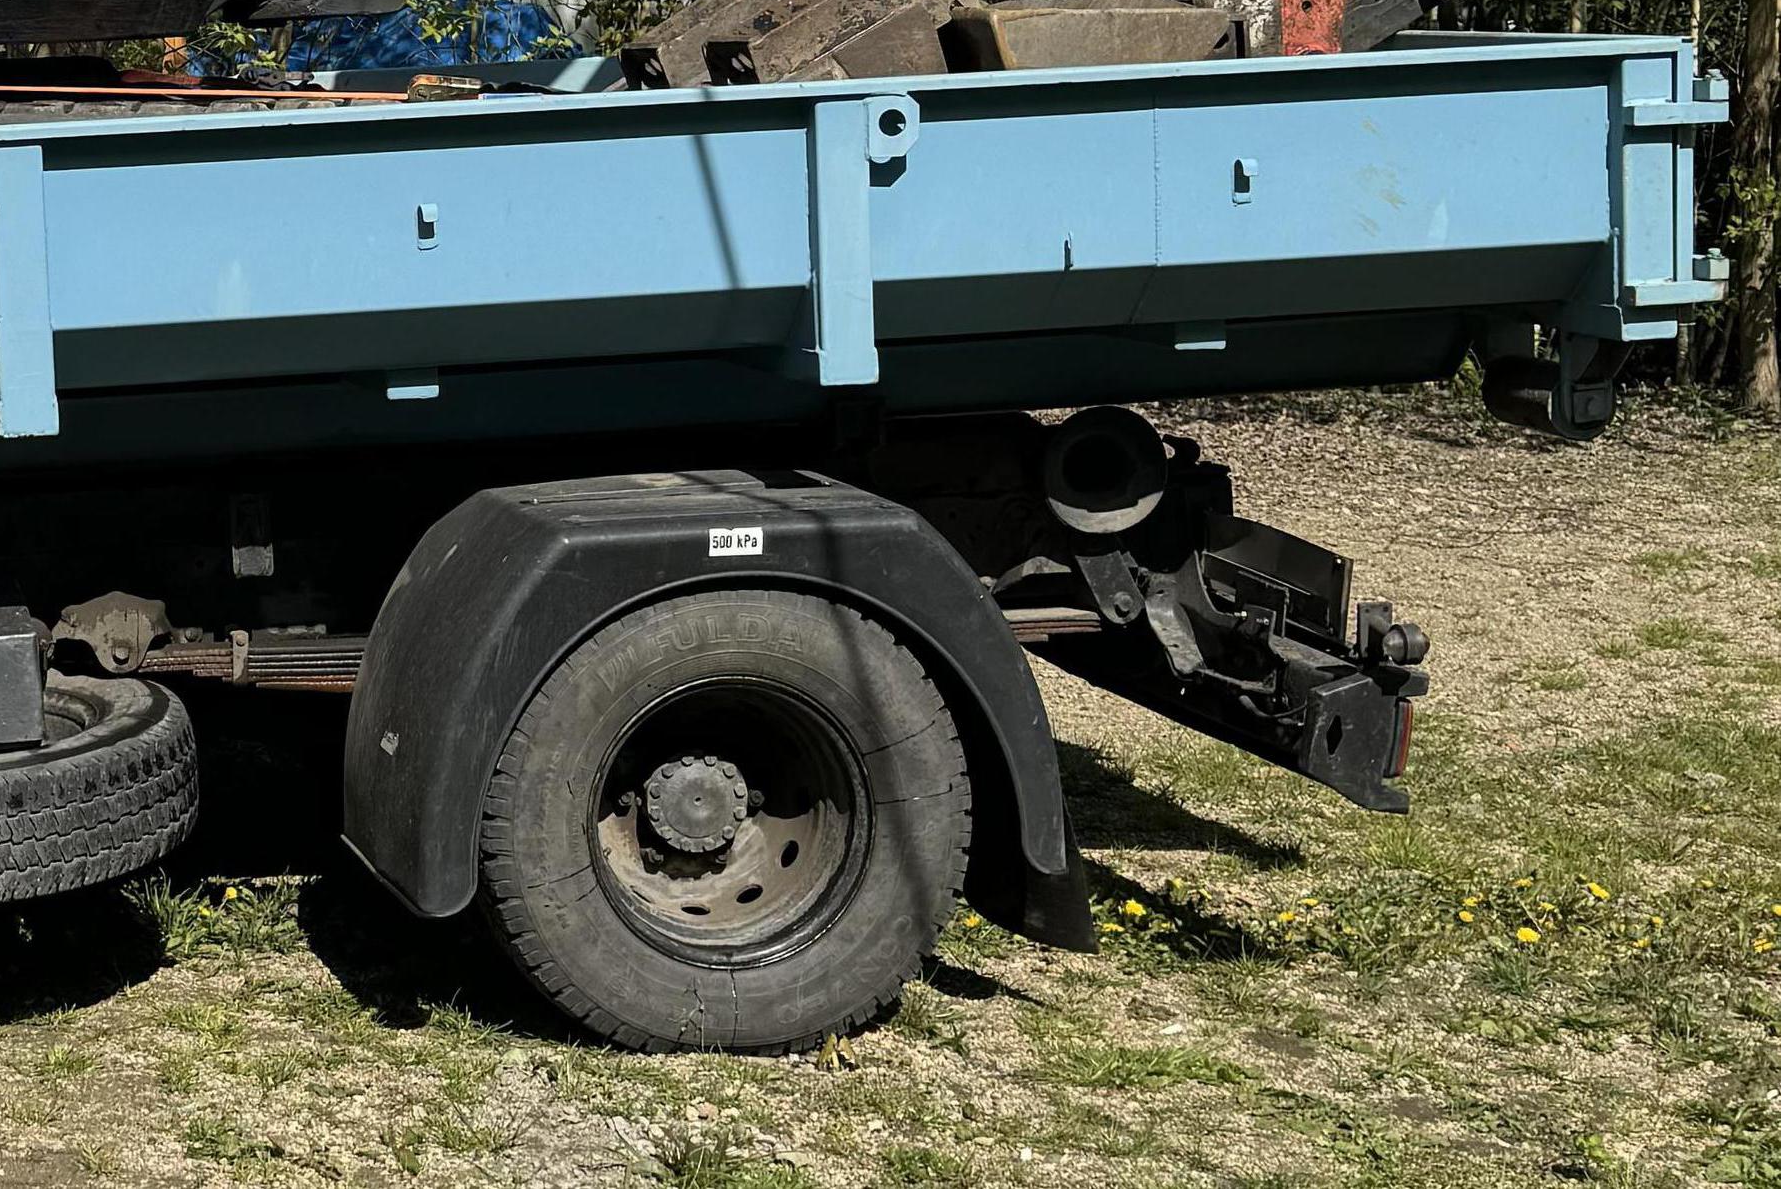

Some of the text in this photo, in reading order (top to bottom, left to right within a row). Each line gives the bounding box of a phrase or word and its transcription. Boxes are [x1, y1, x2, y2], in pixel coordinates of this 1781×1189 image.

[712, 534, 757, 549] 500 kPa
[647, 614, 803, 662] FULDA
